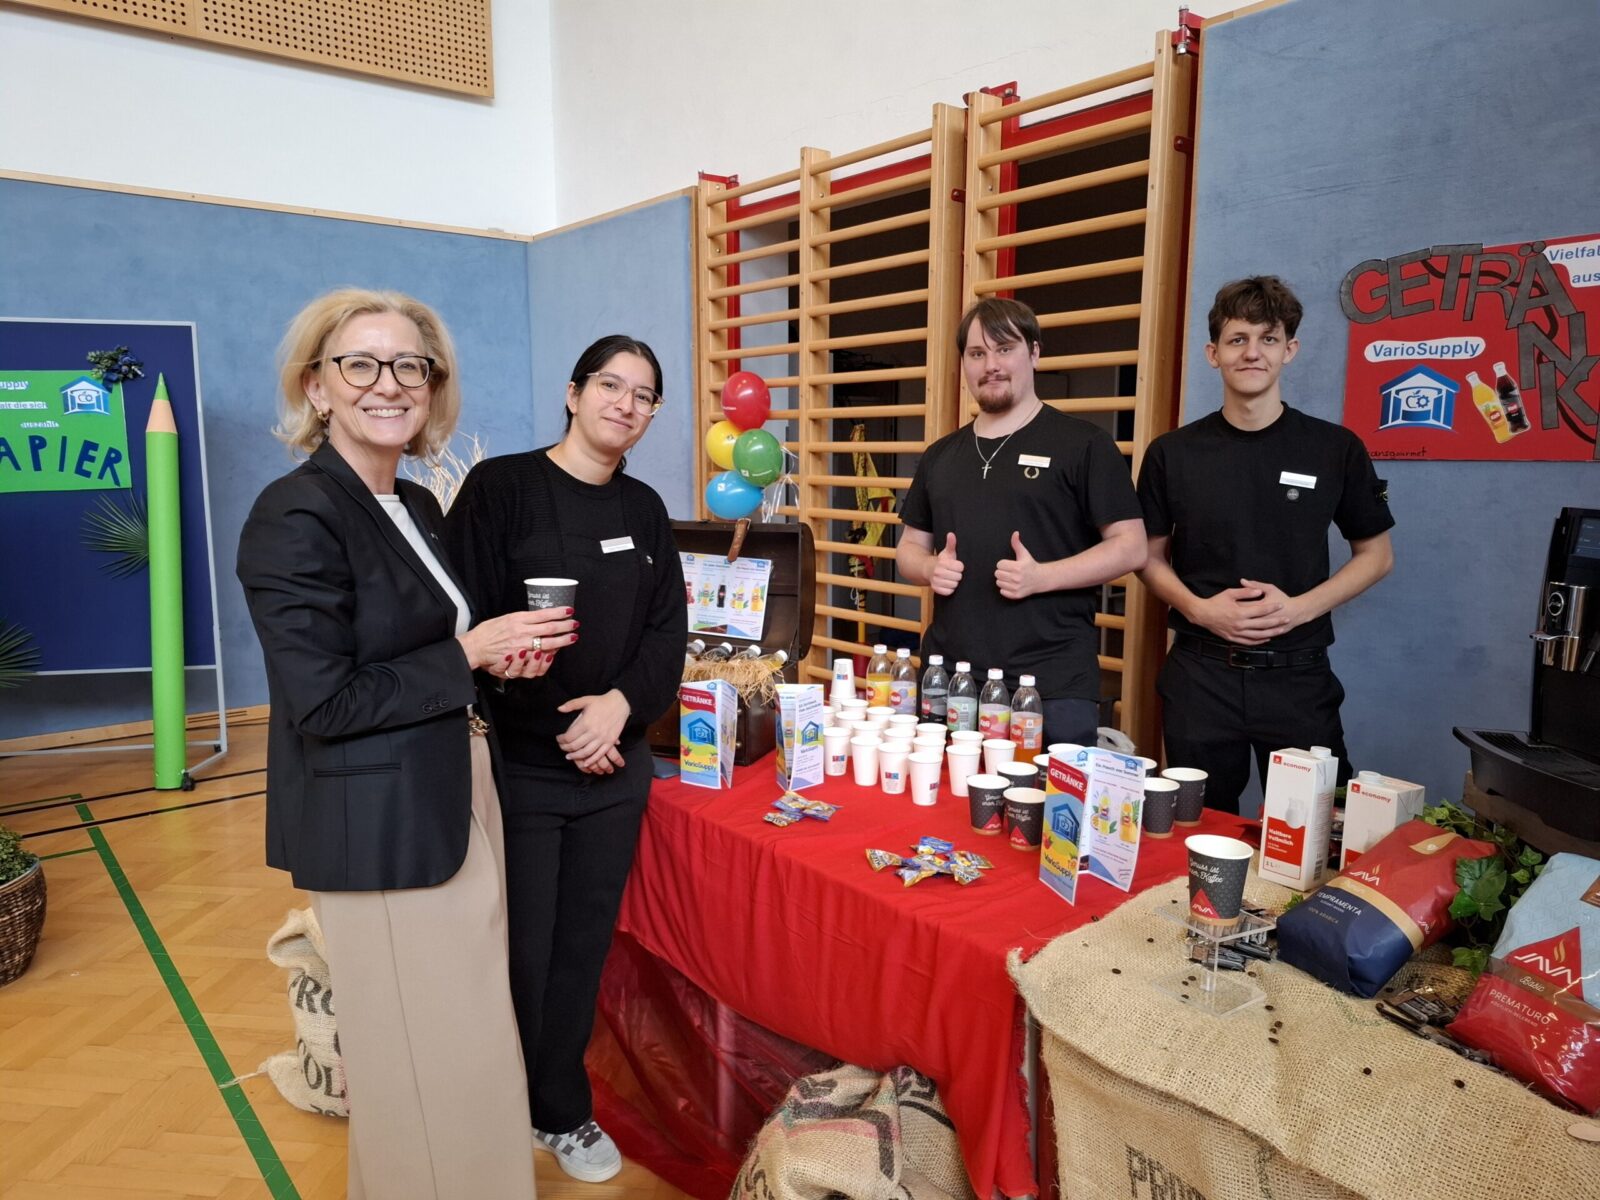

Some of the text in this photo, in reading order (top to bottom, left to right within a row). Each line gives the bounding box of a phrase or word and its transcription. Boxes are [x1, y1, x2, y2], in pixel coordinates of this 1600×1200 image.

[1339, 241, 1600, 460] GETRÄNK
[1373, 341, 1480, 358] VarioSupply
[682, 694, 713, 706] GETRÄNKE
[684, 759, 717, 772] VarioSupply
[1283, 762, 1312, 773] economy
[1050, 767, 1085, 792] GETRÄNKE
[1361, 791, 1391, 803] economy
[1514, 952, 1573, 985] JAVA
[1519, 975, 1546, 993] Basic
[1489, 988, 1551, 1025] PREMATURO
